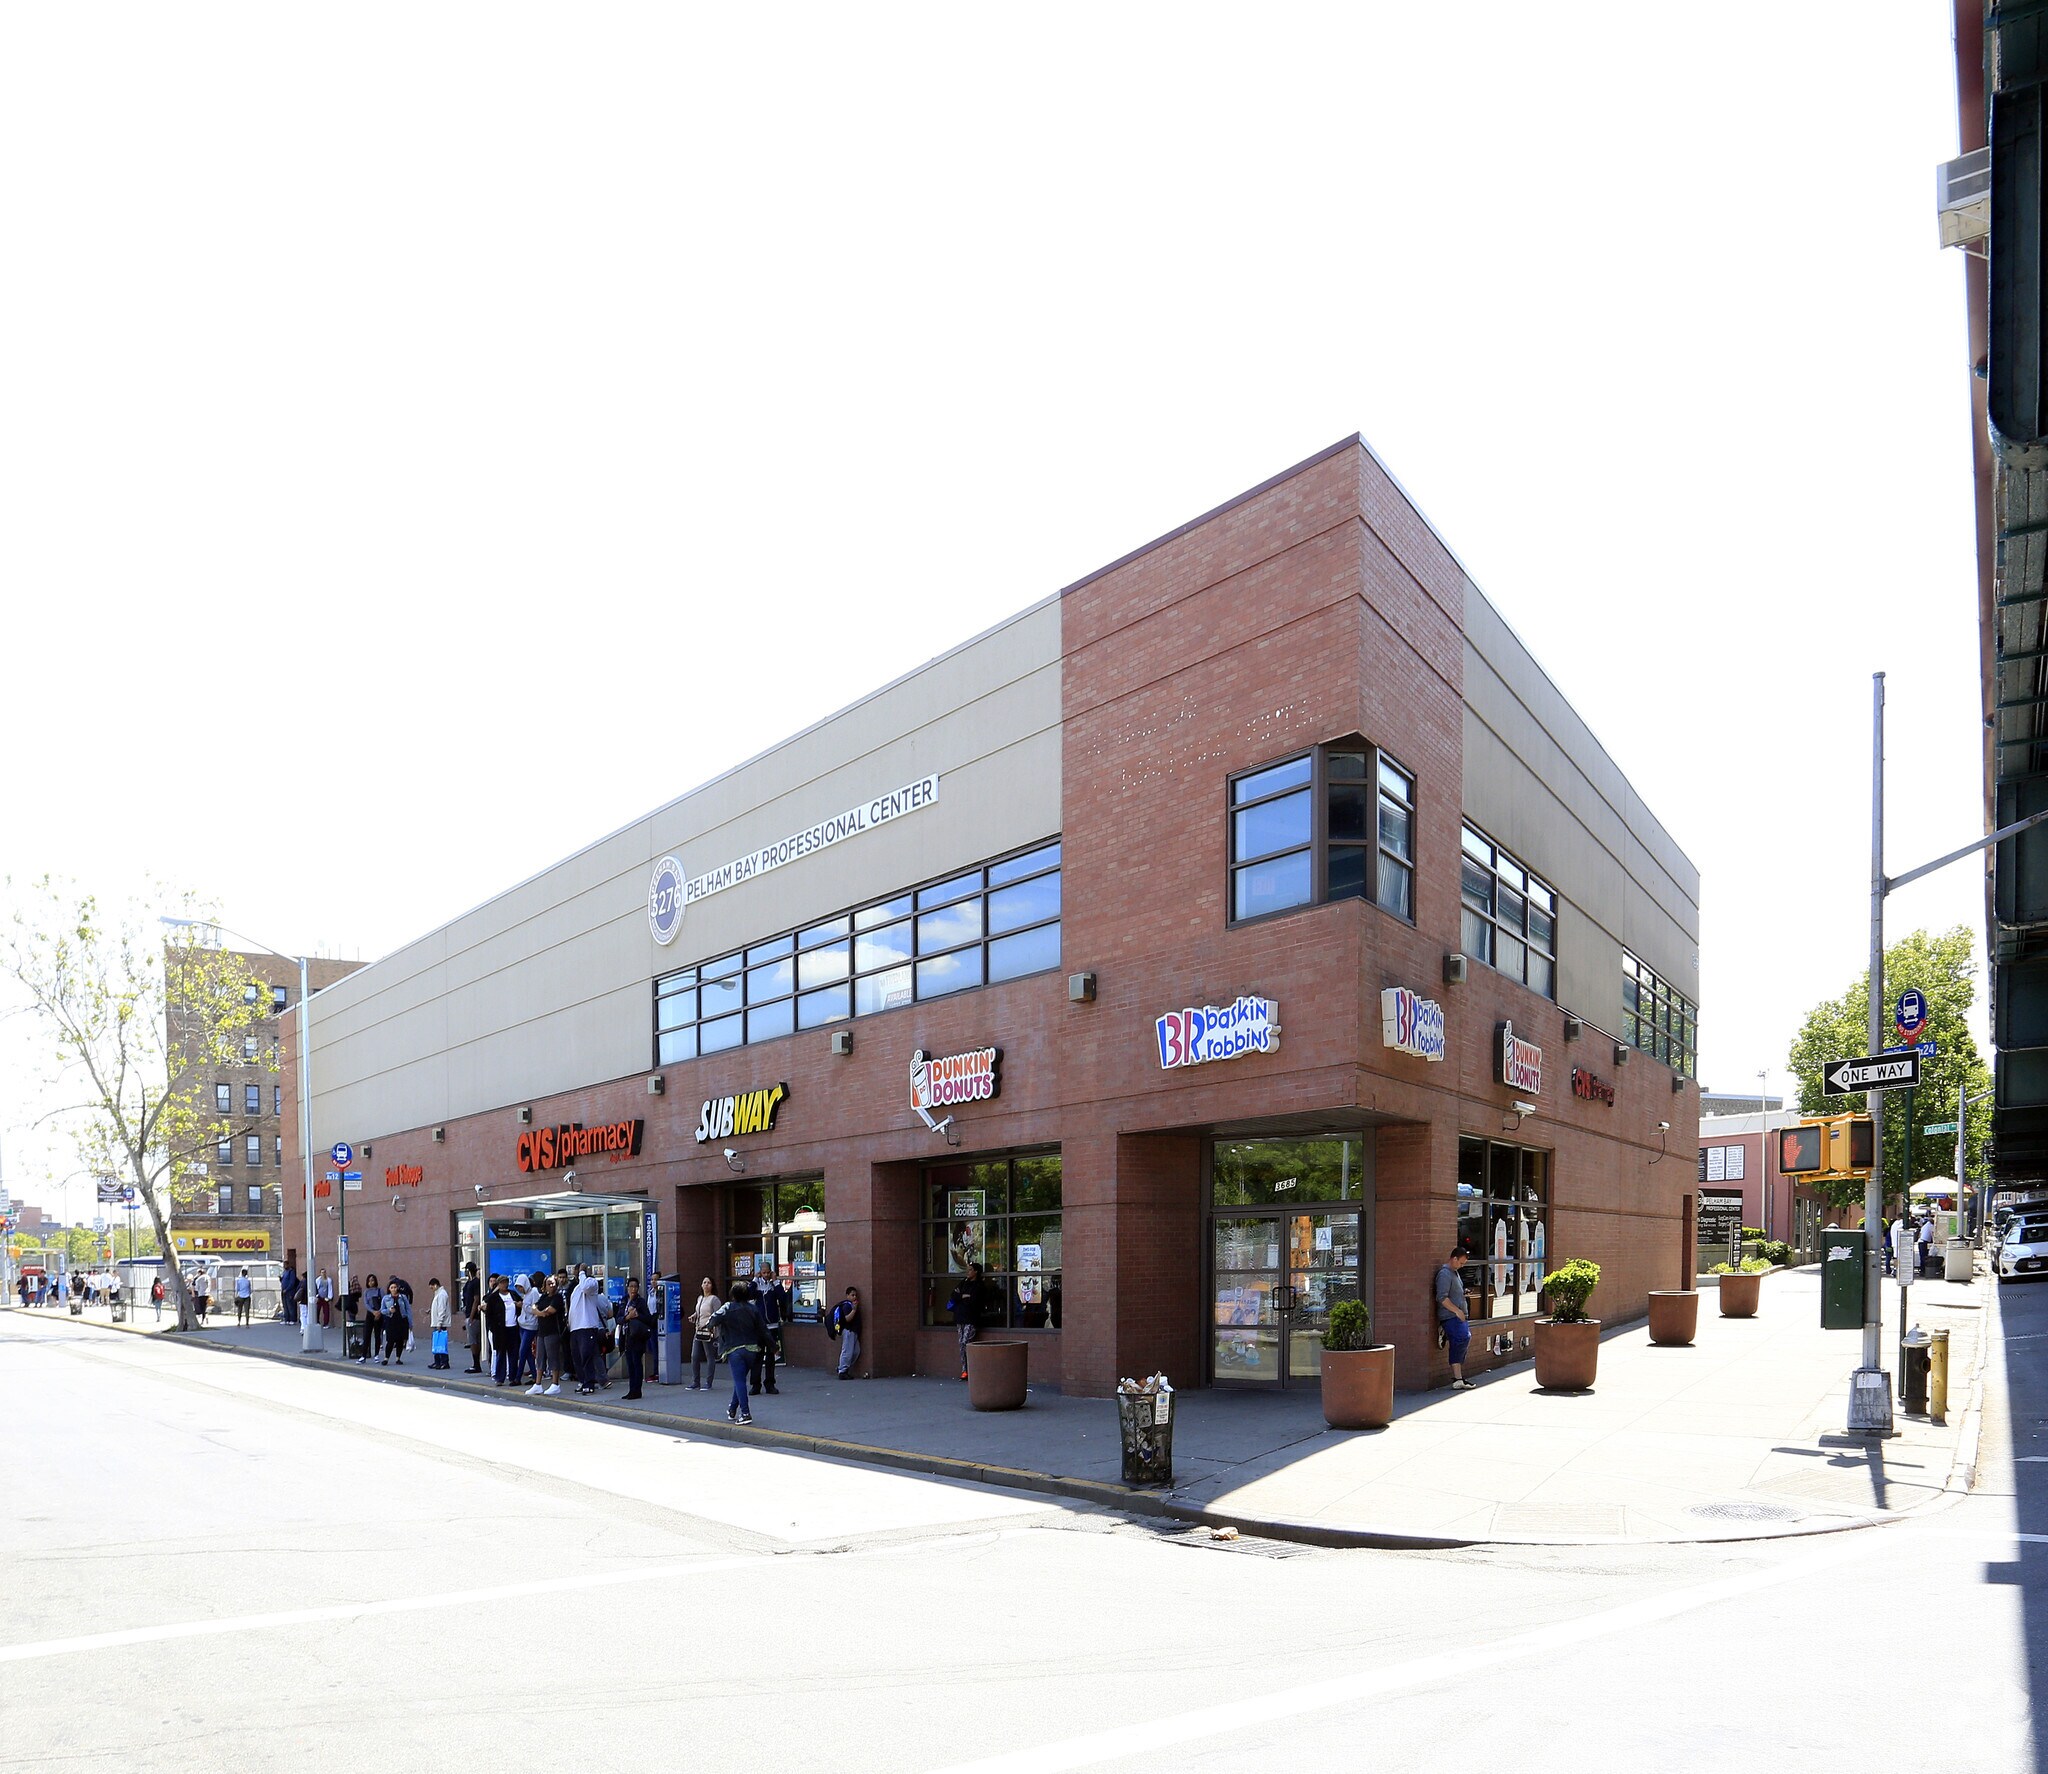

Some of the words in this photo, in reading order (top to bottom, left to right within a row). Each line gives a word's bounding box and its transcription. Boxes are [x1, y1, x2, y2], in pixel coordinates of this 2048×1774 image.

[687, 866, 732, 901] PELHAM
[735, 853, 759, 881] BAY
[762, 809, 866, 870] PROFESSIONAL
[870, 779, 933, 823] CENTER
[650, 884, 681, 918] 3276
[932, 1050, 994, 1082] DUNKIN'
[1515, 1062, 1540, 1094] DONUTS
[1841, 1068, 1869, 1083] ONE
[1876, 1063, 1906, 1079] WAY
[932, 1073, 992, 1103] DONUTS
[694, 1082, 784, 1144] SUBWAY
[1924, 1124, 1950, 1135] Colonial
[516, 1119, 636, 1174] CVS/pharmacy
[1275, 1179, 1296, 1191] 3685
[954, 1208, 979, 1217] COOKIES
[211, 1237, 234, 1249] BUY
[1318, 1230, 1330, 1245] A
[734, 1260, 751, 1268] CARVED
